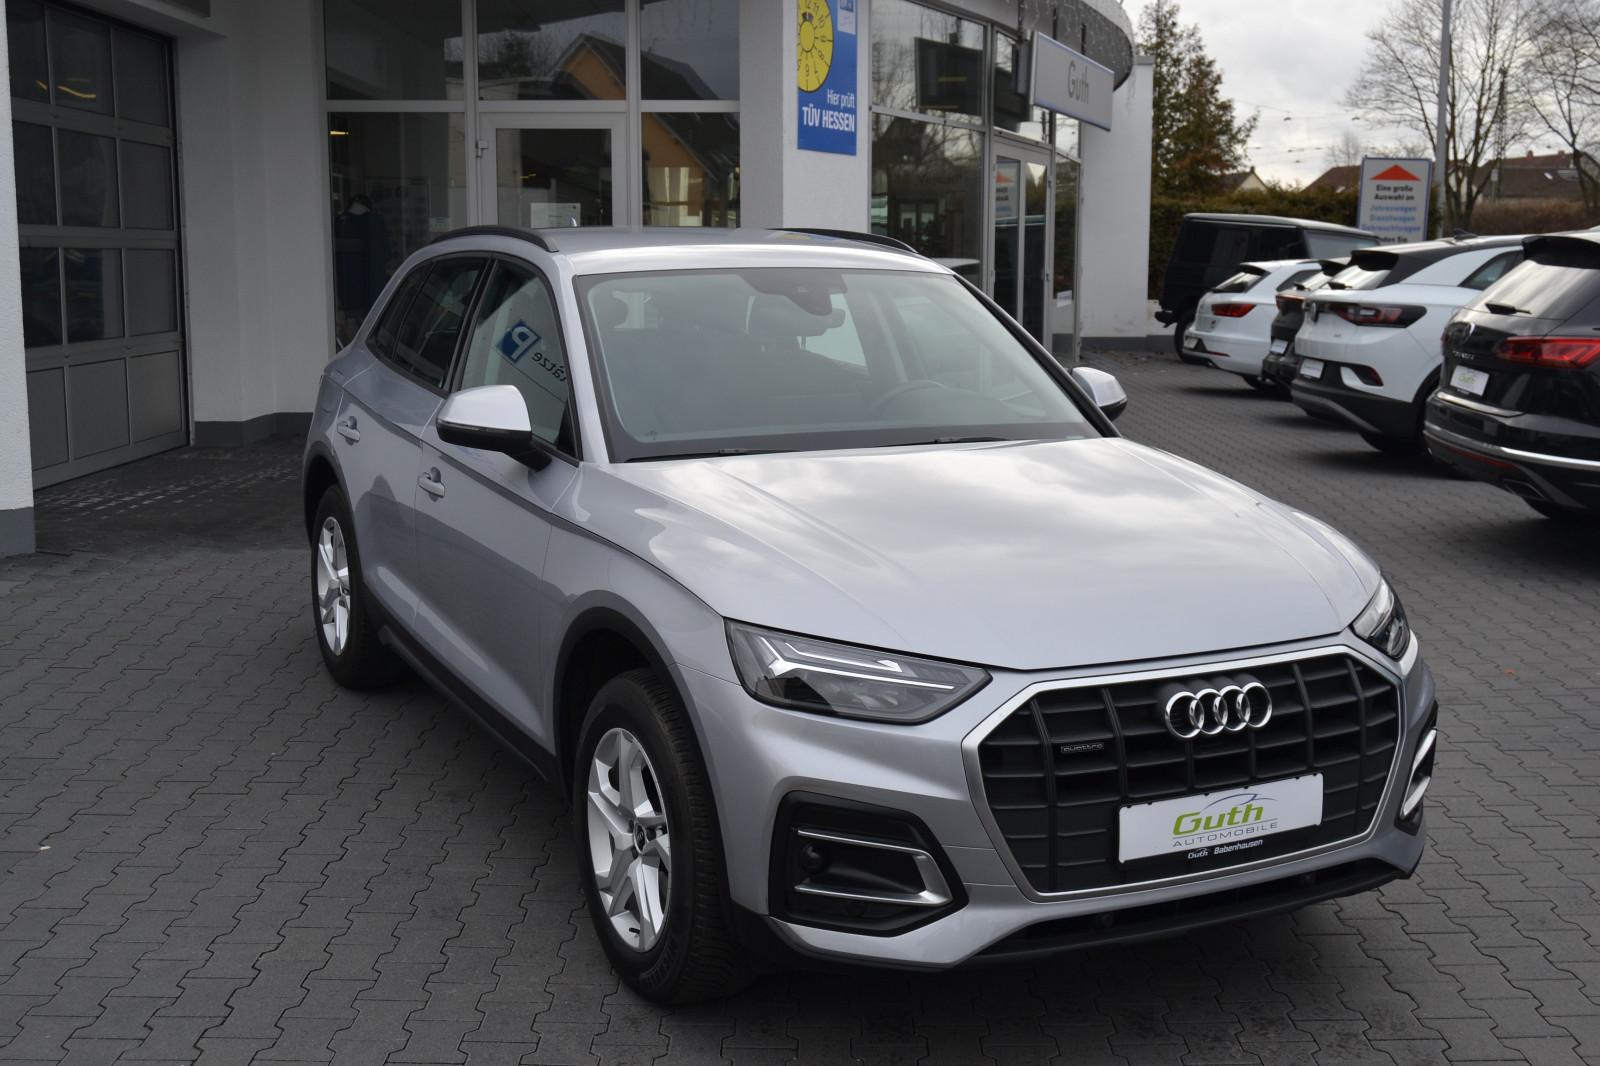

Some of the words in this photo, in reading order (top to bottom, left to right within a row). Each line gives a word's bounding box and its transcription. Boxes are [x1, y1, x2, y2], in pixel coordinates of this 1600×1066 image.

[1067, 60, 1089, 104] Guth
[827, 88, 840, 105] Hier
[840, 91, 855, 109] prüft
[802, 104, 820, 127] TÜV
[822, 110, 855, 133] HESSEN
[1376, 184, 1391, 192] Eine
[1393, 184, 1413, 192] große
[1172, 803, 1264, 836] Guth
[1172, 822, 1278, 848] AUTOMOBILE
[1187, 848, 1209, 859] Guth
[1214, 839, 1263, 855] Babenhausen
